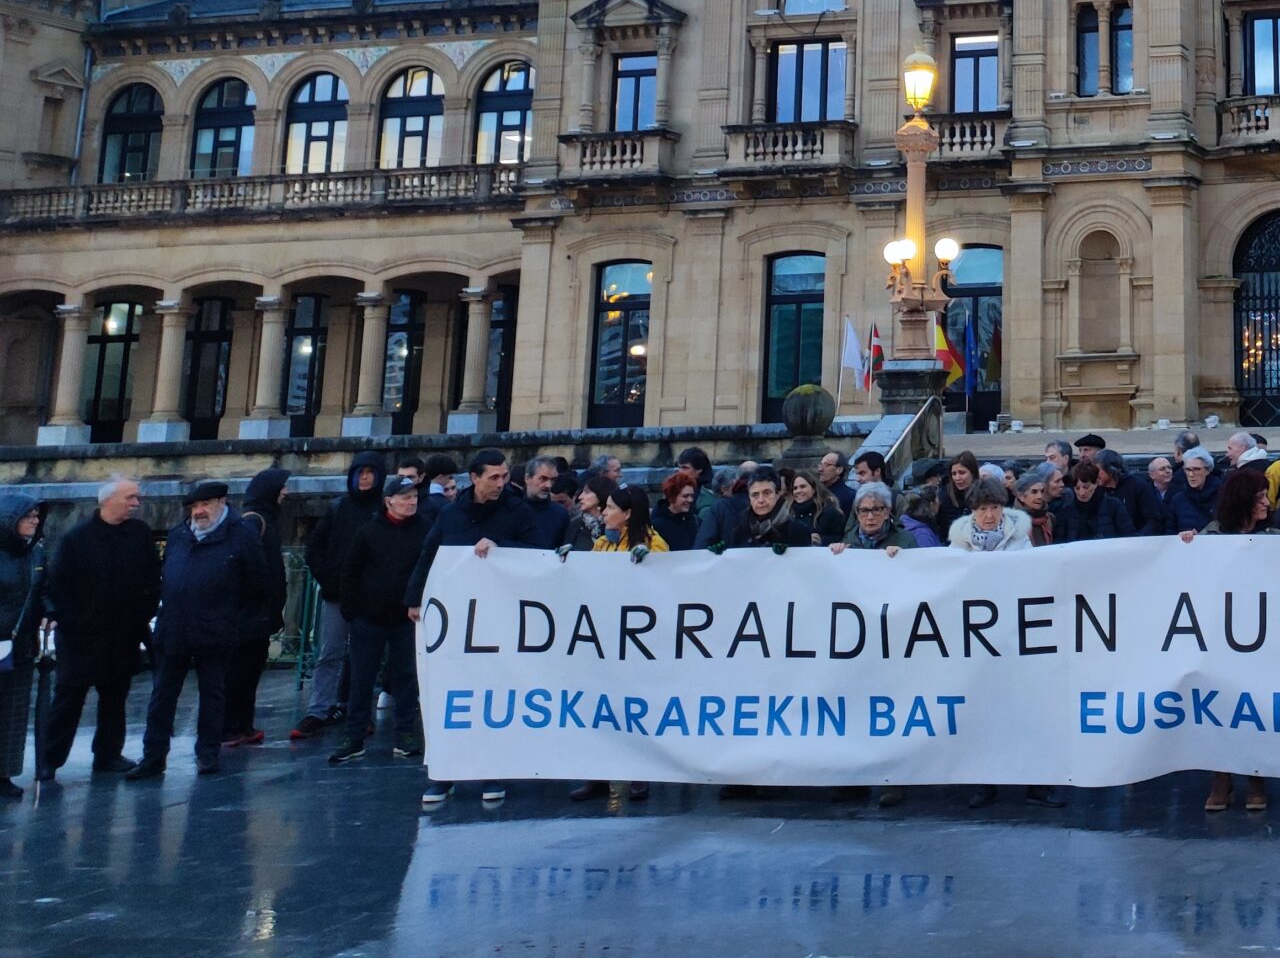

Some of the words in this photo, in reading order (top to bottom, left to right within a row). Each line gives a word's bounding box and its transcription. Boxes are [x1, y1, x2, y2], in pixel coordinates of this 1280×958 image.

[422, 593, 1117, 660] OLDARRALDIAREN
[443, 687, 846, 736] EUSKARAREKIN
[869, 695, 966, 737] BAT
